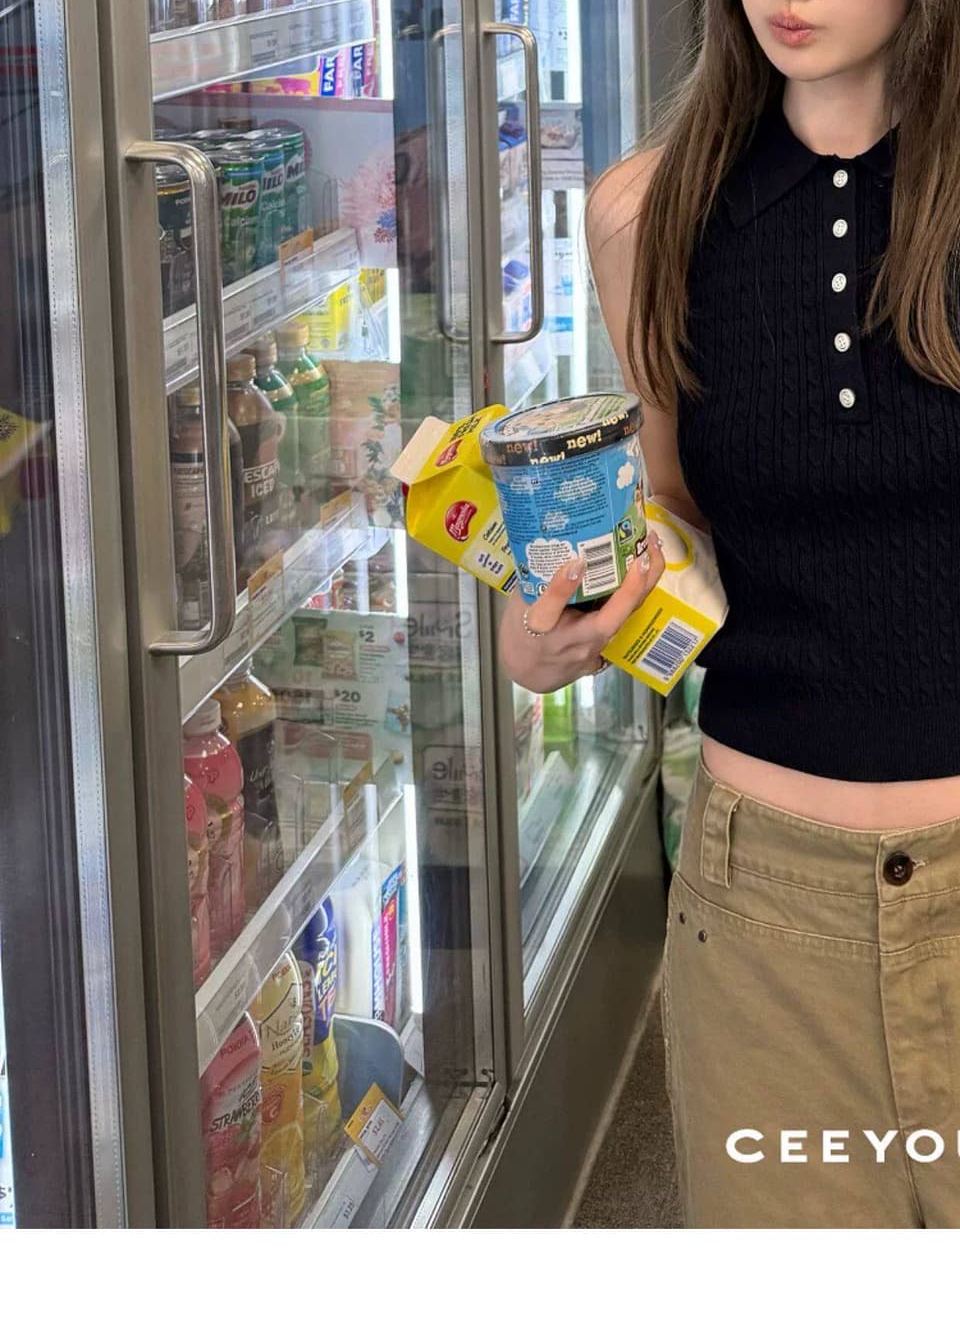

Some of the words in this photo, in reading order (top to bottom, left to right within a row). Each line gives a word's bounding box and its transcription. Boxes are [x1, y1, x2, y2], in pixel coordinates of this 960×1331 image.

[566, 429, 602, 450] new!
[506, 440, 539, 454] new!
[334, 690, 361, 702] $20
